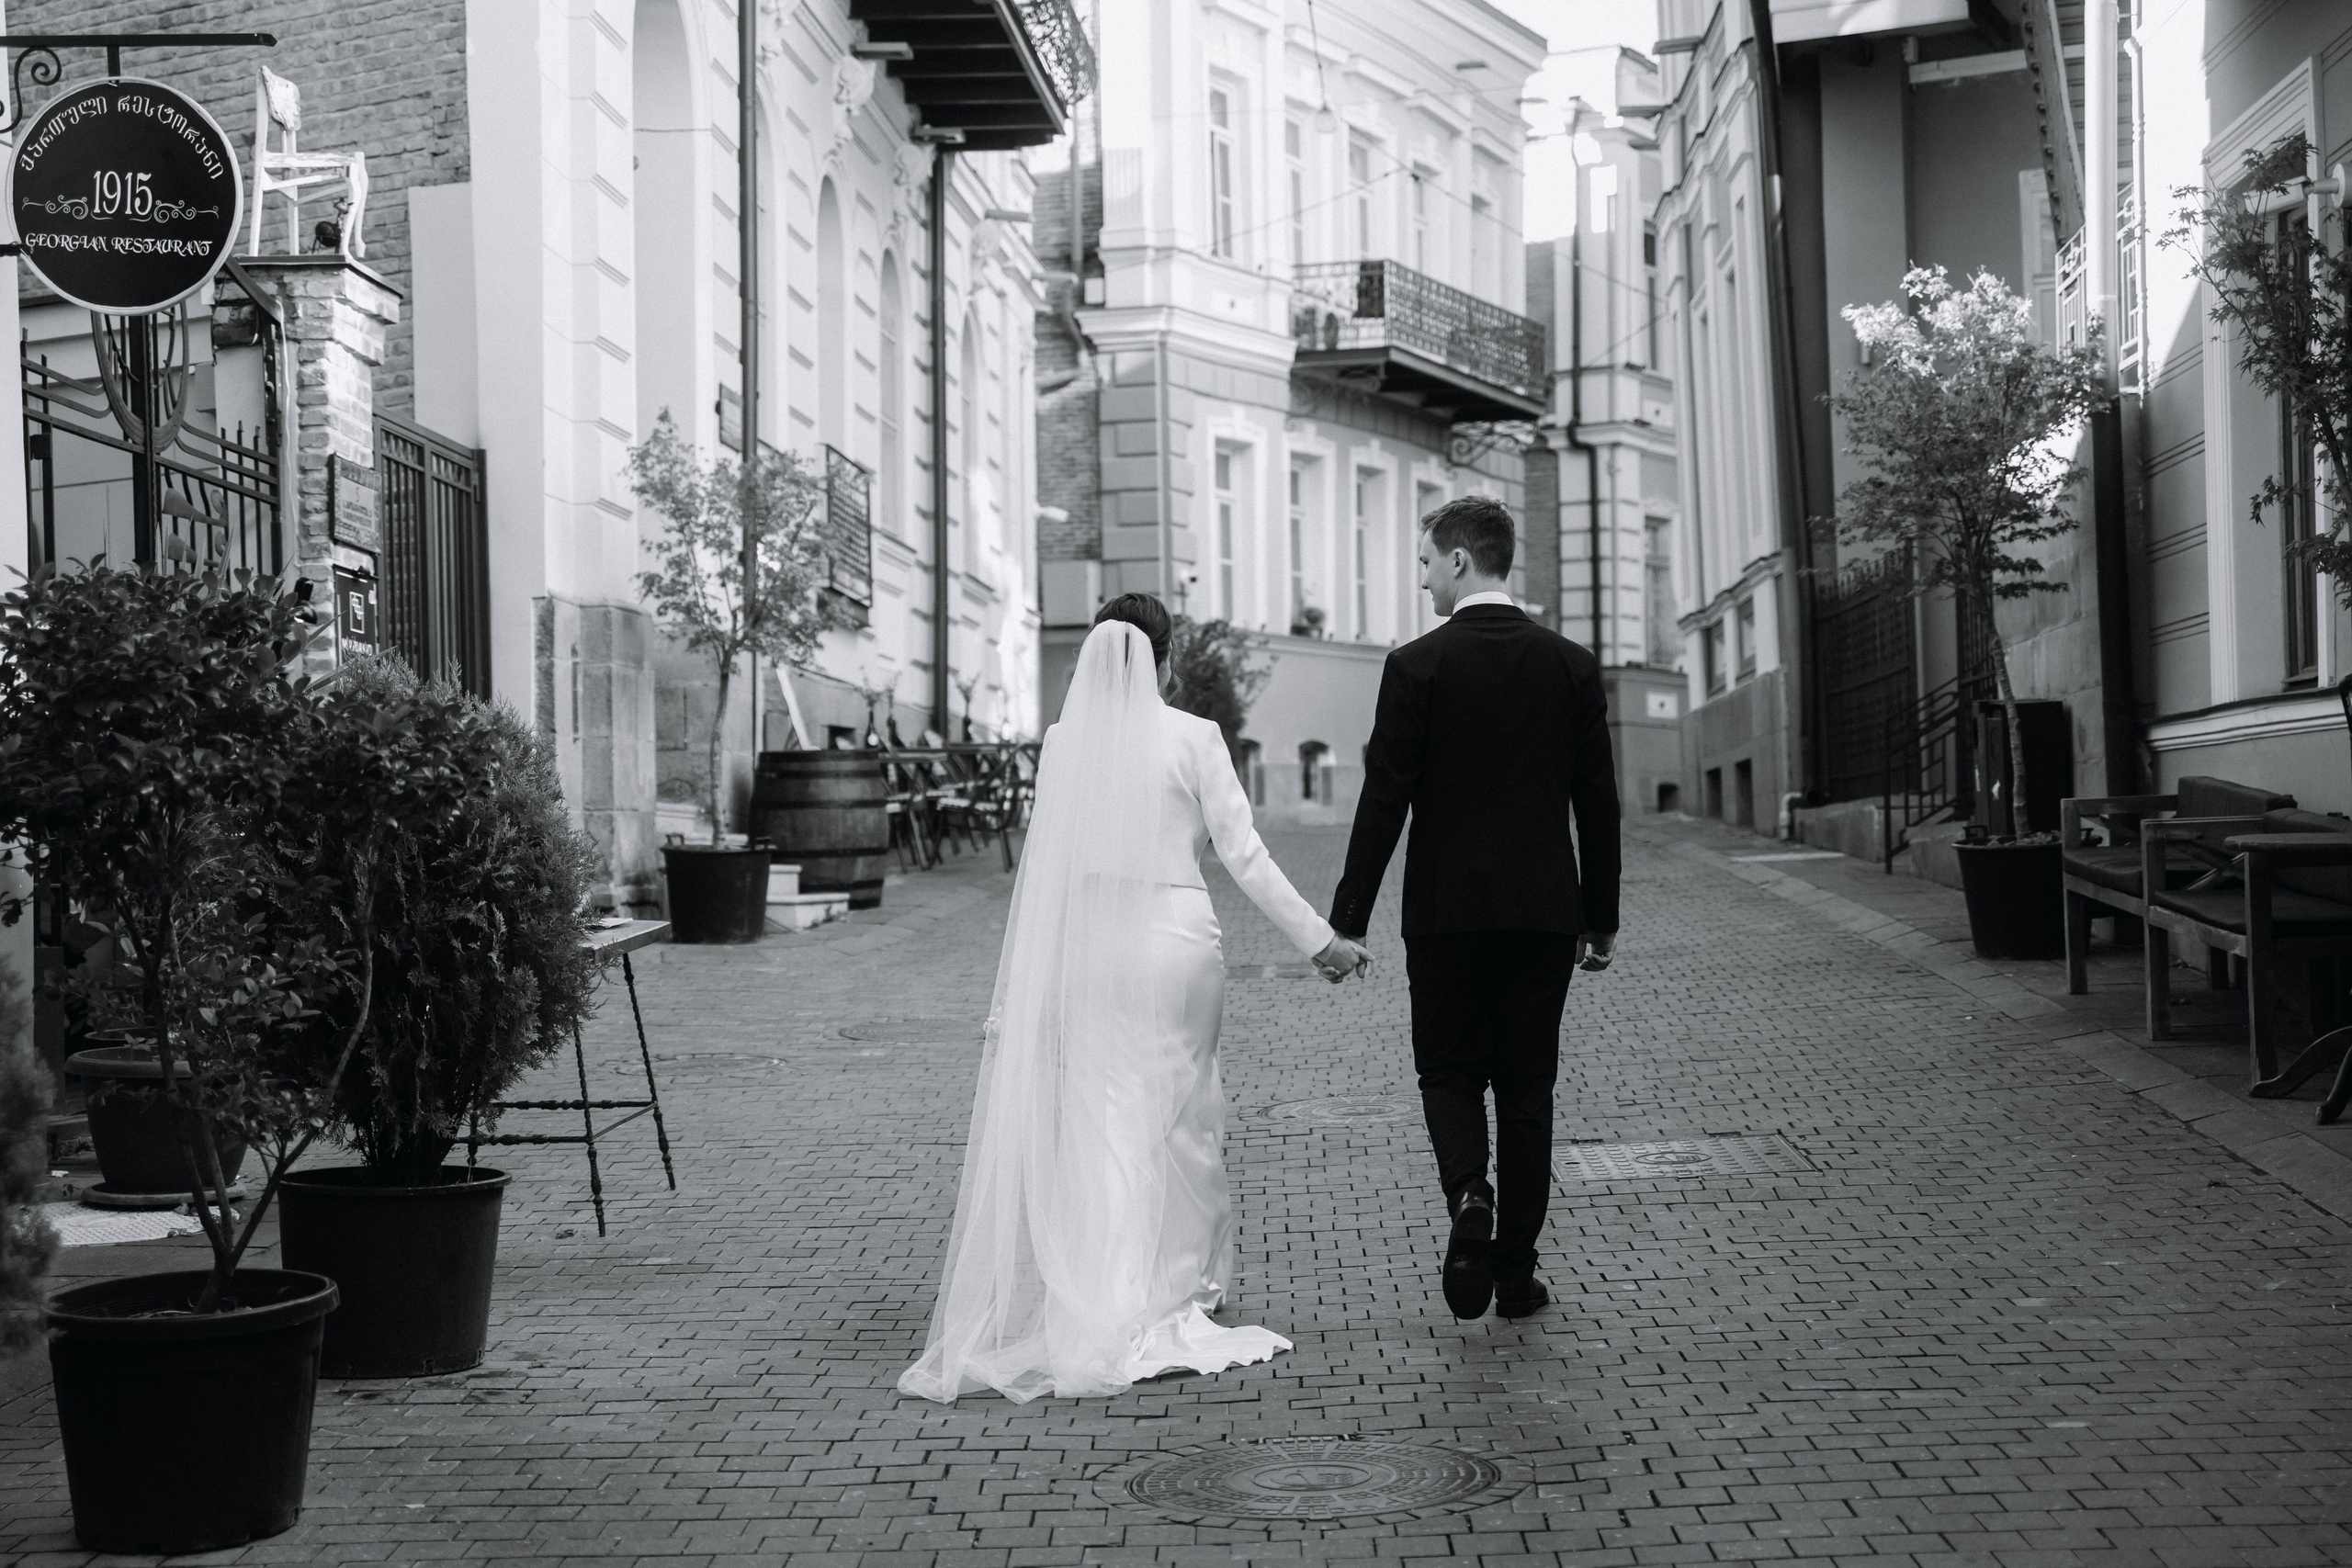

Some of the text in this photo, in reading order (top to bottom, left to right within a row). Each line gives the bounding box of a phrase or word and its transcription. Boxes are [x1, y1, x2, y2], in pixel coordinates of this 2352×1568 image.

[19, 95, 225, 180] ქართული რესტორანი
[93, 170, 153, 216] 1915
[26, 232, 212, 257] GEORGIAN RESTAURANT
